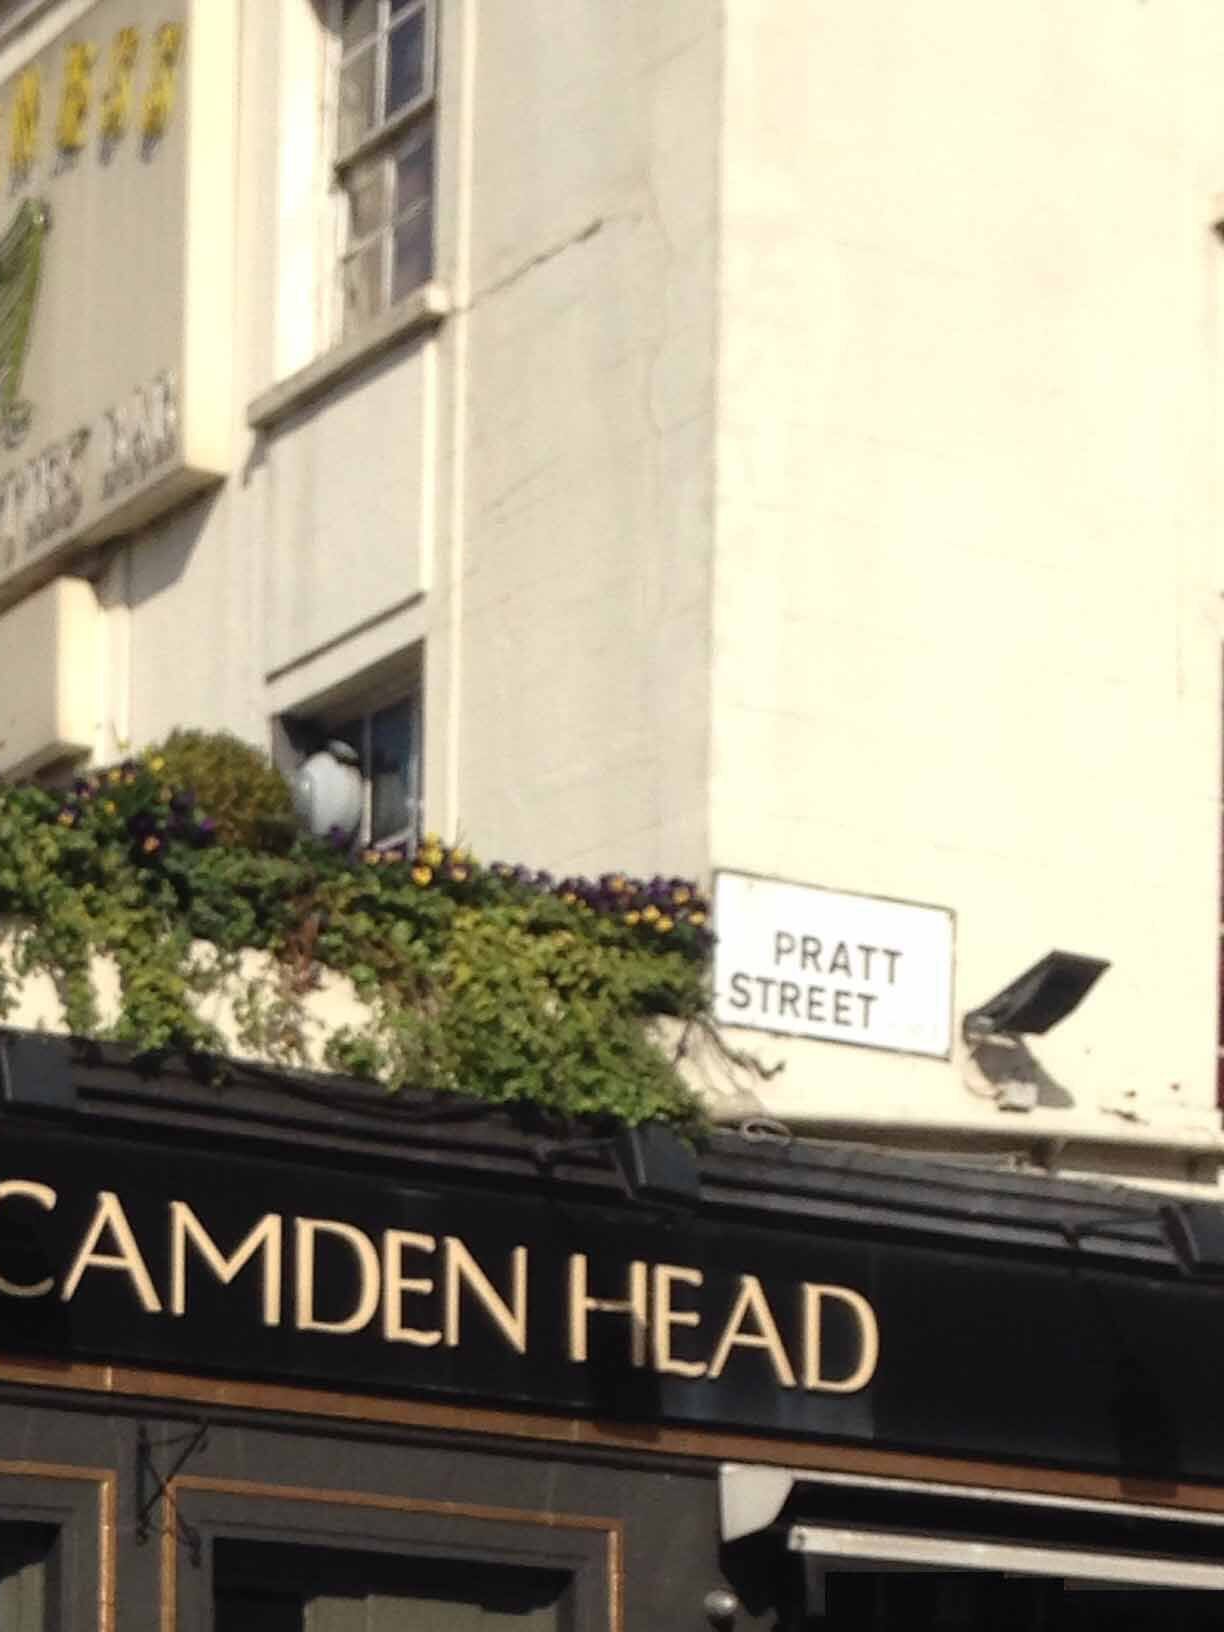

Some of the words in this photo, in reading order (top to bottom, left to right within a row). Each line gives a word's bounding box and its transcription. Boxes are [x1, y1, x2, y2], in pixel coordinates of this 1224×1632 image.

[774, 929, 904, 986] PRATT
[729, 970, 879, 1029] STREET
[568, 1254, 880, 1393] HEAD
